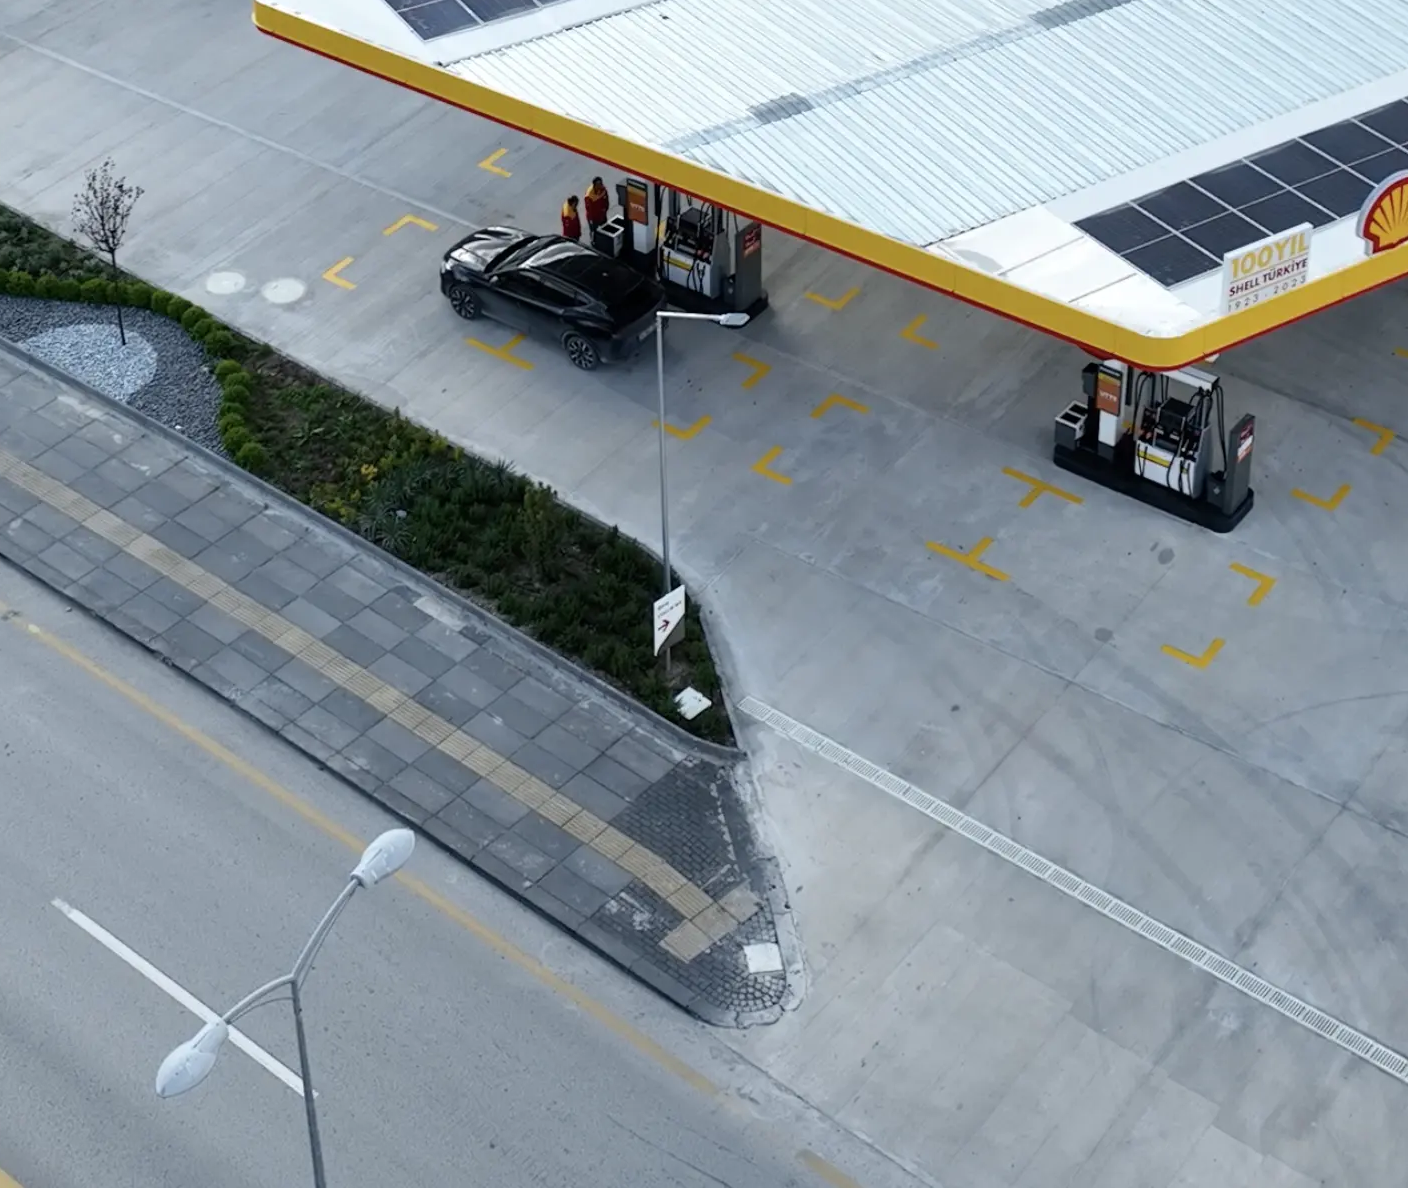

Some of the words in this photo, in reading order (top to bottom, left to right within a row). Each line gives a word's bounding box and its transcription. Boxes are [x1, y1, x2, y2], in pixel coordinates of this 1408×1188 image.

[1228, 293, 1259, 313] 1923
[1273, 275, 1307, 294] 2023
[1229, 276, 1261, 297] SHELL
[1262, 258, 1308, 283] TÜRKİYE
